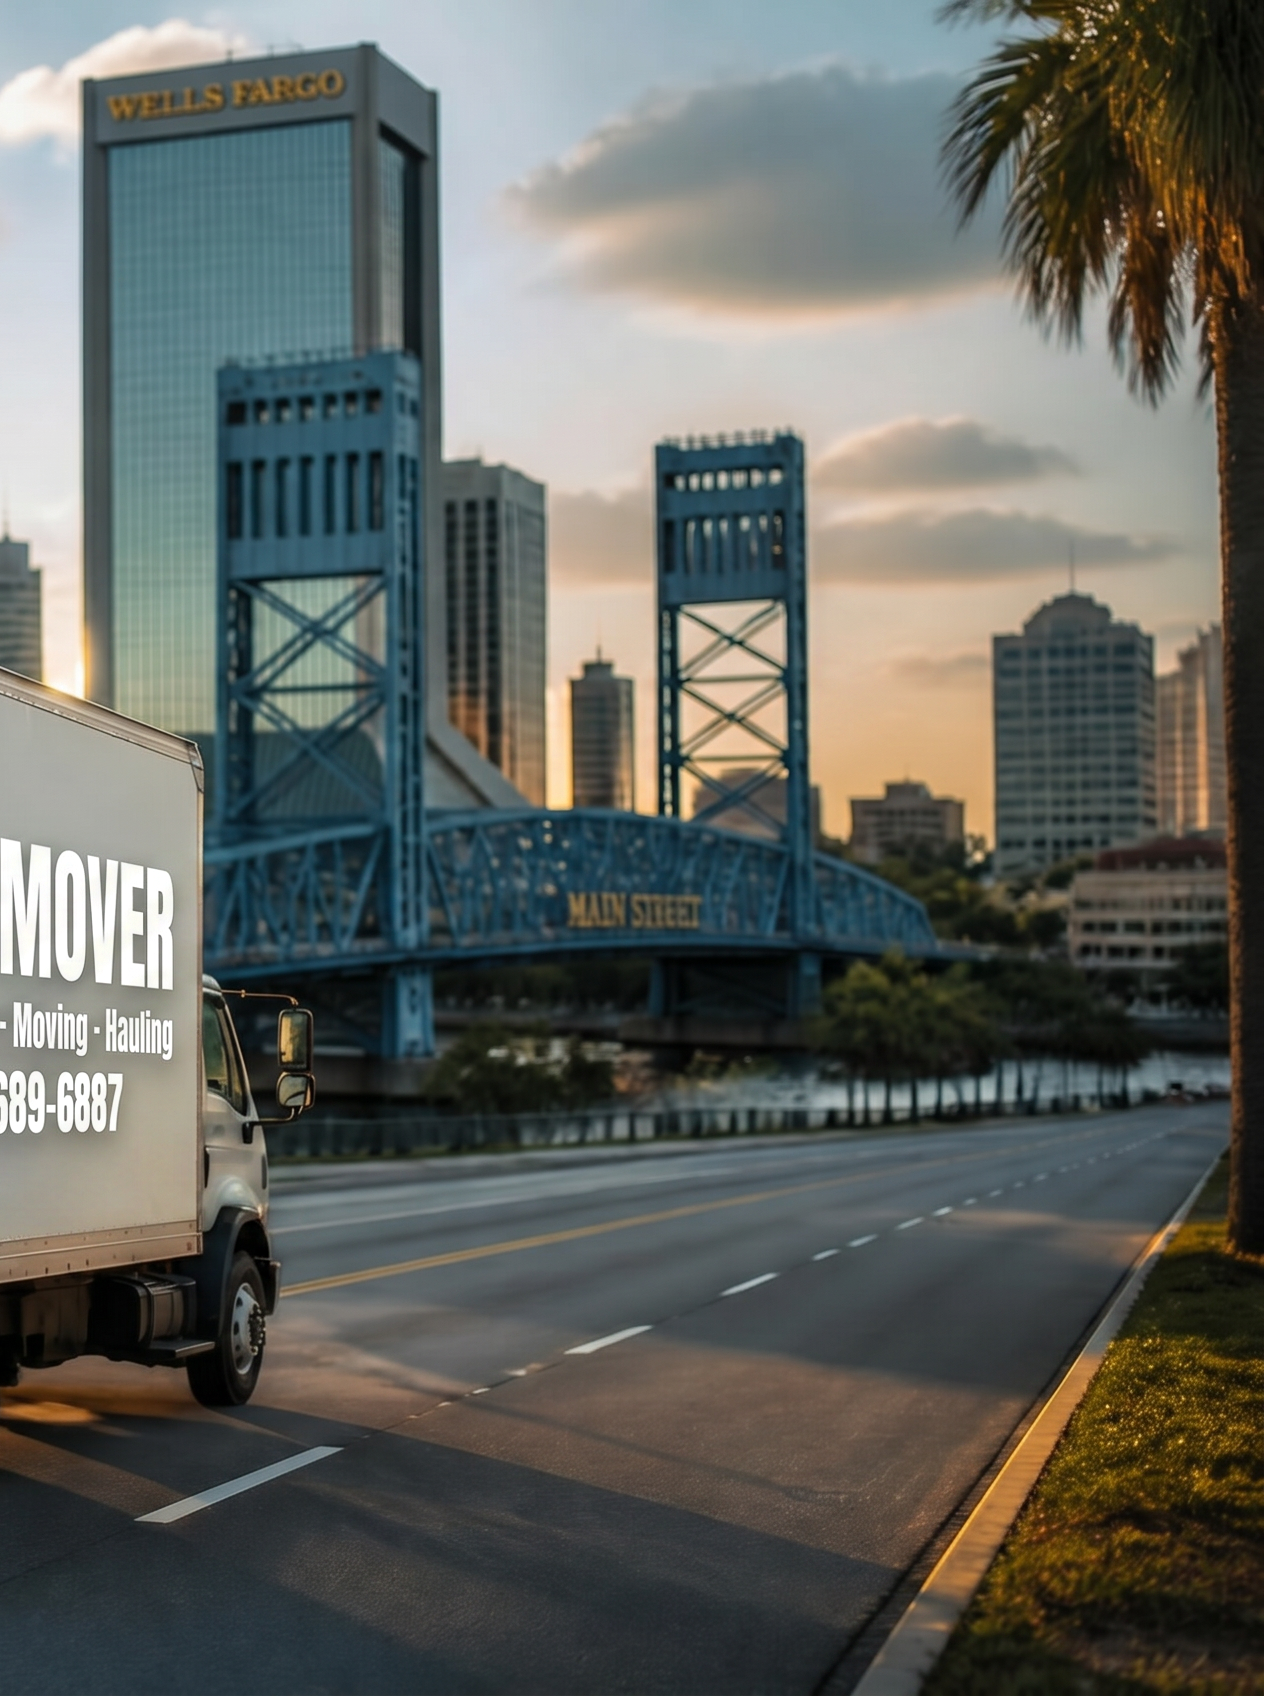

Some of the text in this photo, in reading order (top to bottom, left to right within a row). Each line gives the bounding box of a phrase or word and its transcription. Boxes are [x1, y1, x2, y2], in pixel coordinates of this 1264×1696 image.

[107, 70, 344, 121] WELLS FARGO
[0, 837, 174, 990] MOVER
[568, 892, 626, 928] MAIN
[13, 1001, 88, 1057] Moving
[105, 1008, 173, 1061] Hauling
